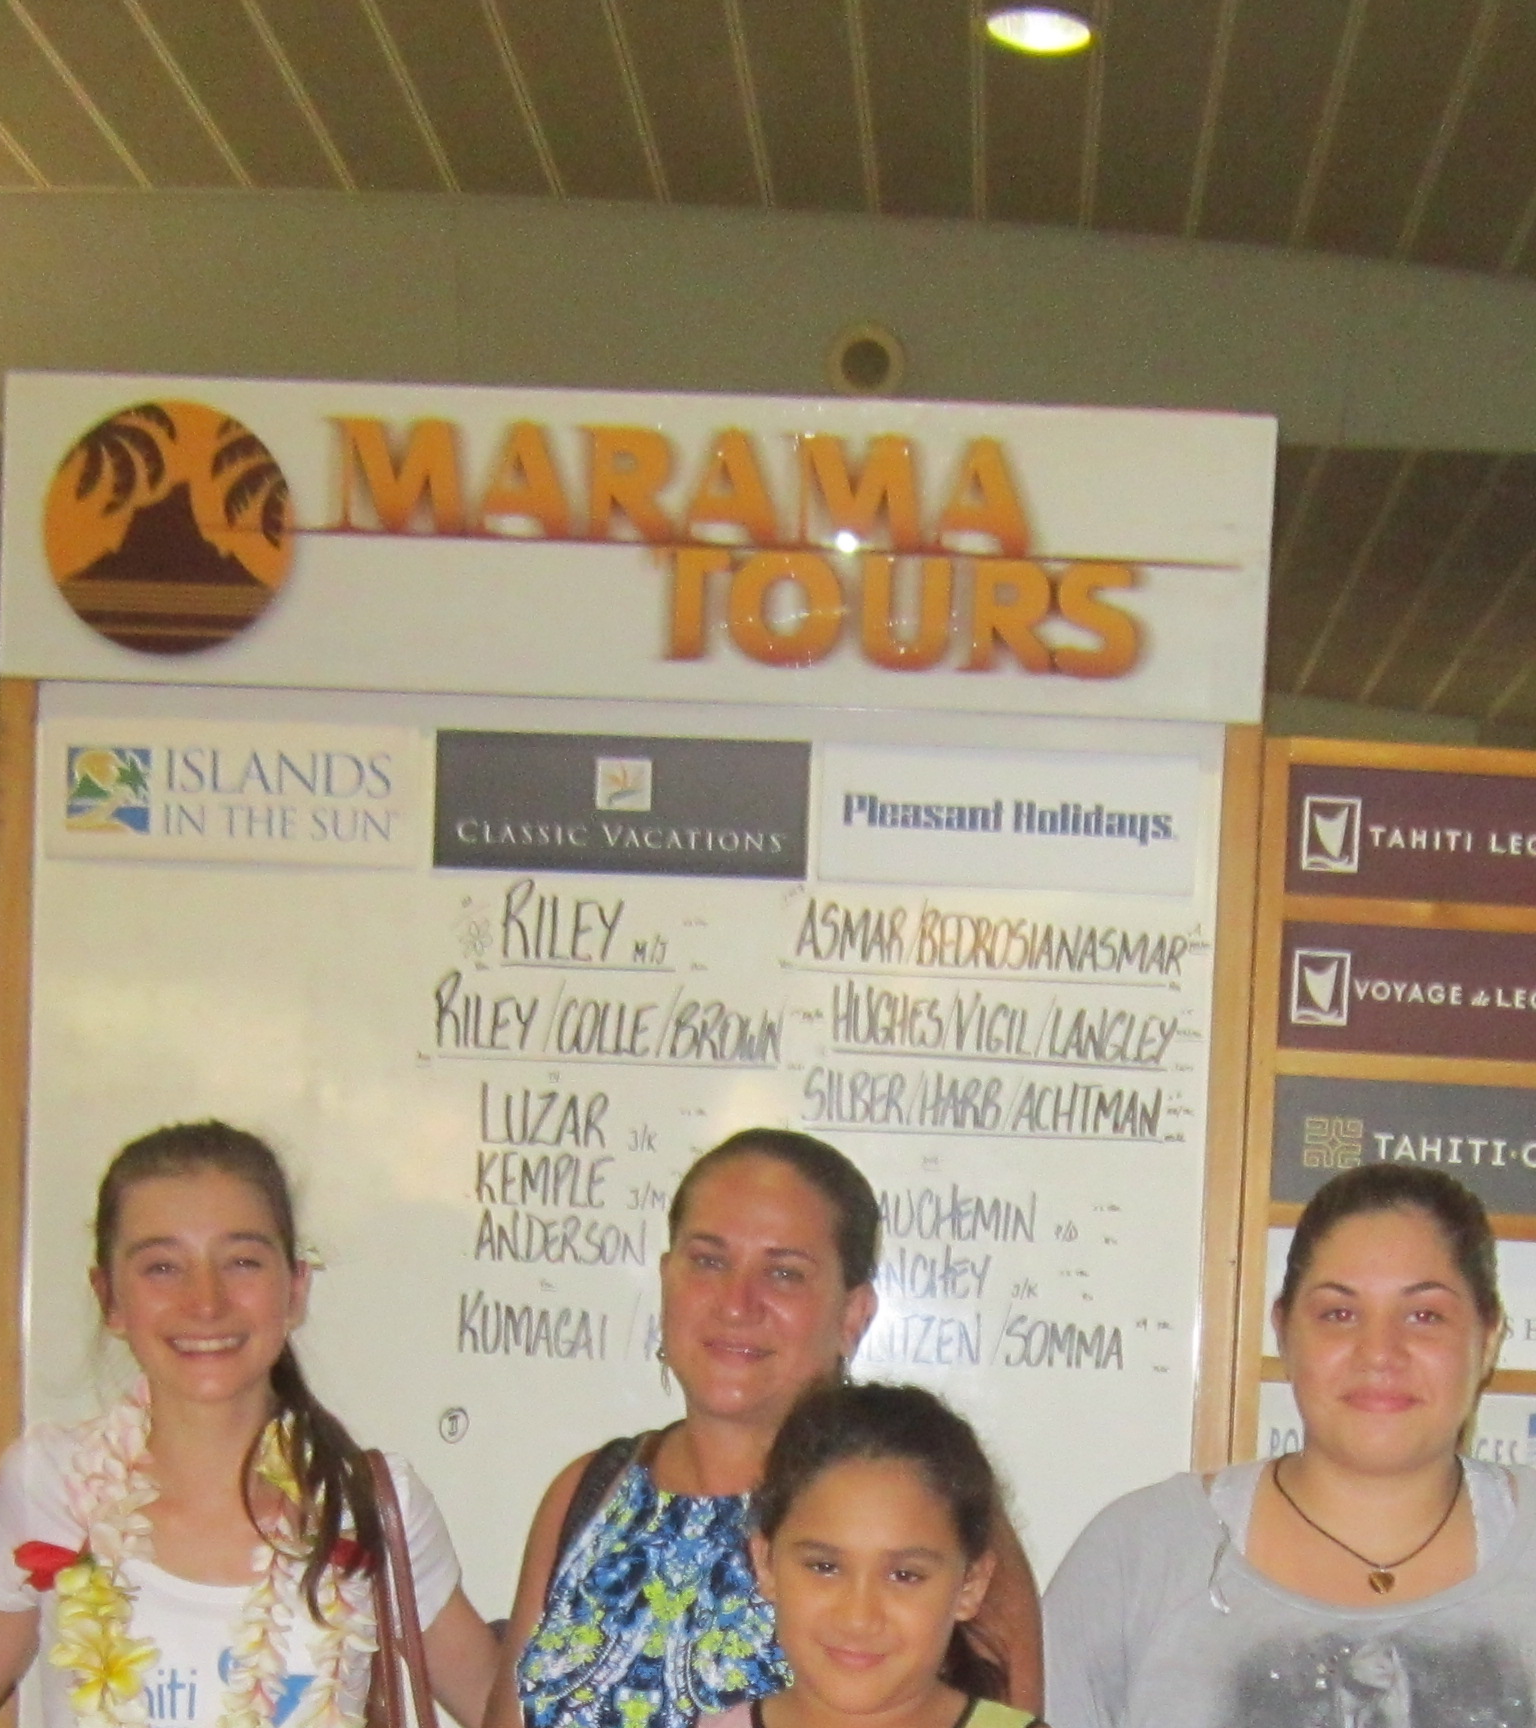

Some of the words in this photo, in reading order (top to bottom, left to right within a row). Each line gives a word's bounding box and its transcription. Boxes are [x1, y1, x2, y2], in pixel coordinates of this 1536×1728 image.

[327, 415, 1032, 557] MARAMA
[654, 543, 1146, 679] TOURS
[166, 746, 392, 798] ISLANDS
[166, 804, 207, 836] IN
[226, 806, 296, 839] THE
[312, 809, 391, 843] SUN
[457, 820, 587, 848] CLASSIC
[602, 823, 783, 854] VACATIONS
[843, 792, 1002, 832] Pleasant
[1014, 800, 1173, 846] Holidays
[1369, 825, 1473, 853] TAHITI
[502, 877, 625, 963] RILEY
[1353, 979, 1462, 1006] VOYAGE
[1471, 990, 1490, 1007] de
[481, 1081, 610, 1149] LUZAR
[474, 1151, 614, 1209] KEMPLE
[474, 1208, 647, 1267] ANDERSON
[878, 1184, 1037, 1244] AUCHEMIN
[457, 1289, 608, 1361] KUMAGAI
